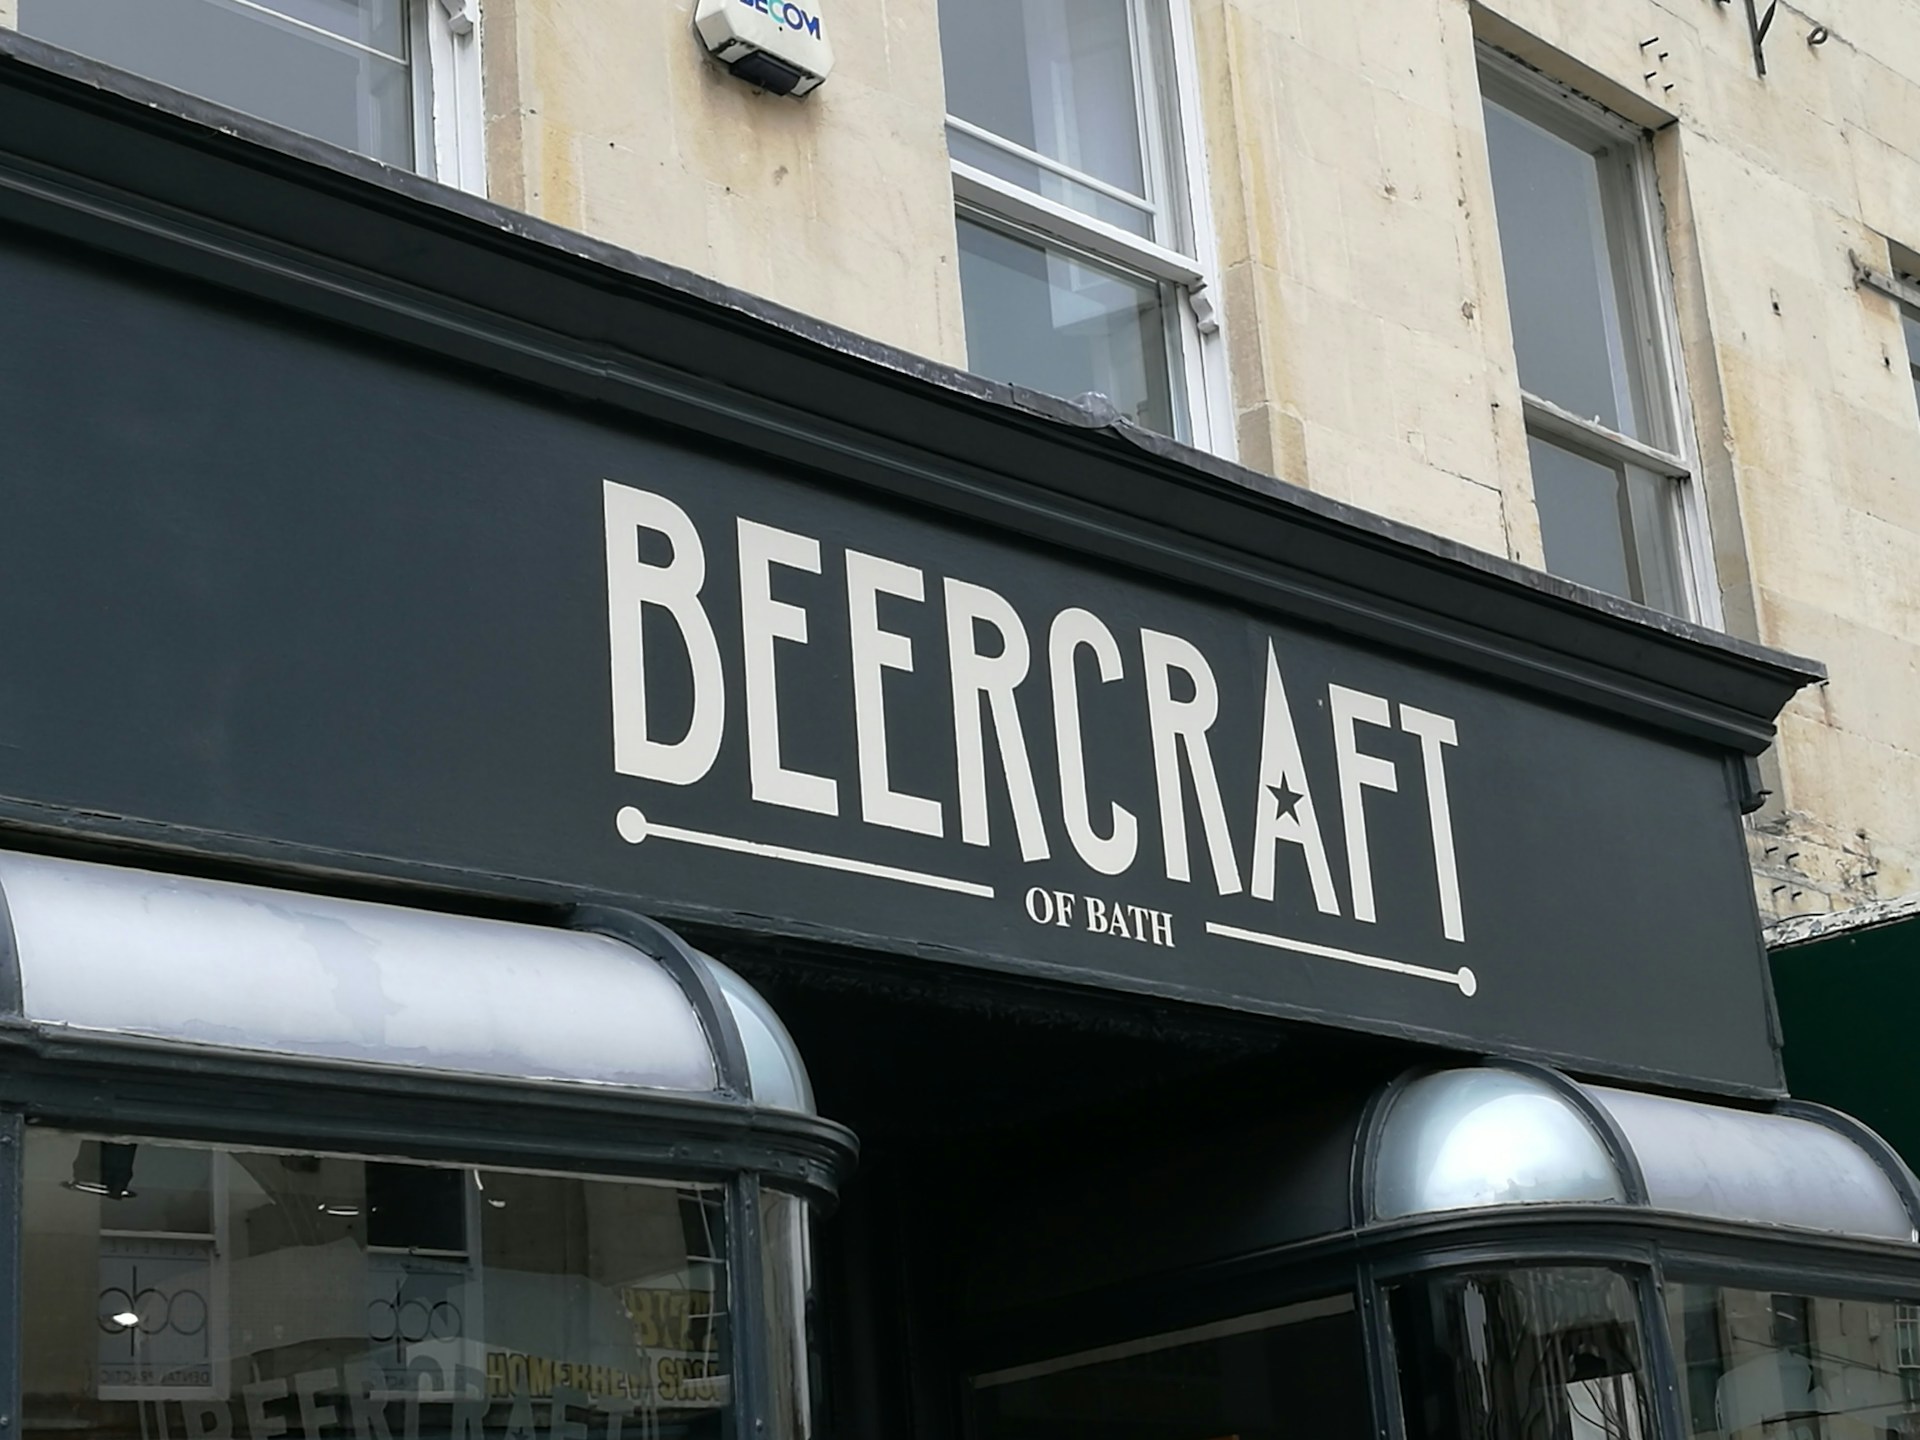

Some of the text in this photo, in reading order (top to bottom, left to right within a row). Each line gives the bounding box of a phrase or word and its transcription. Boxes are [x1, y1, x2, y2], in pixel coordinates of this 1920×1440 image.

[738, 0, 821, 41] ECOM
[603, 479, 1465, 943] BEERCRAFT
[1025, 886, 1176, 948] OF BATH
